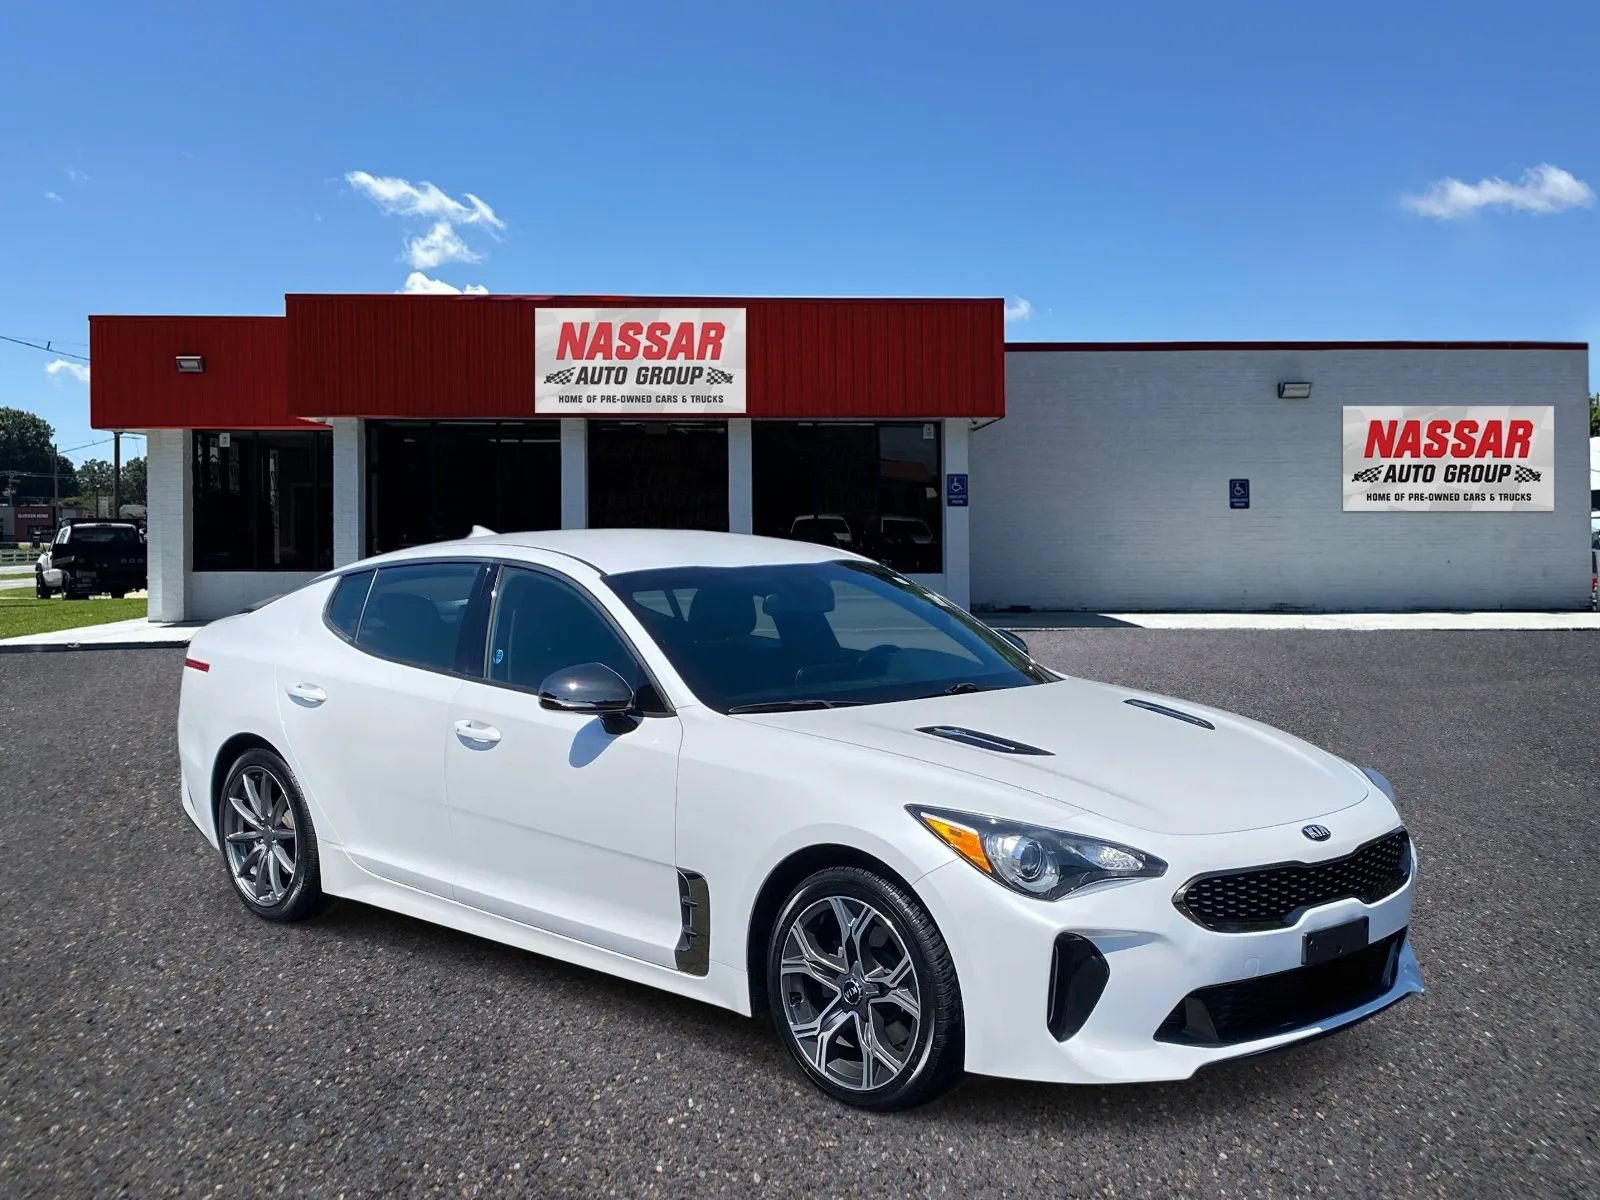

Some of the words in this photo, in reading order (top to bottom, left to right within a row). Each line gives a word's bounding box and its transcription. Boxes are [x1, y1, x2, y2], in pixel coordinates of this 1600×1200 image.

[556, 322, 725, 361] NASSAR
[575, 366, 628, 385] AUTO
[635, 366, 703, 385] GROUP
[559, 395, 583, 403] HOME
[587, 395, 597, 403] OF
[601, 395, 652, 403] PRE-OWNED
[655, 395, 678, 403] CARS
[682, 395, 687, 403] &
[691, 395, 724, 403] TRUCKS
[1364, 420, 1533, 458] NASSAR
[1383, 464, 1436, 482] AUTO
[1443, 464, 1511, 482] GROUP
[1366, 493, 1390, 501] HOME
[1395, 493, 1405, 501] OF
[1408, 493, 1459, 501] PRE-OWNED
[1463, 493, 1486, 501] CARS
[1489, 493, 1495, 501] &
[1499, 493, 1532, 501] TRUCKS
[1303, 825, 1330, 839] KIA
[844, 986, 858, 999] KIA
